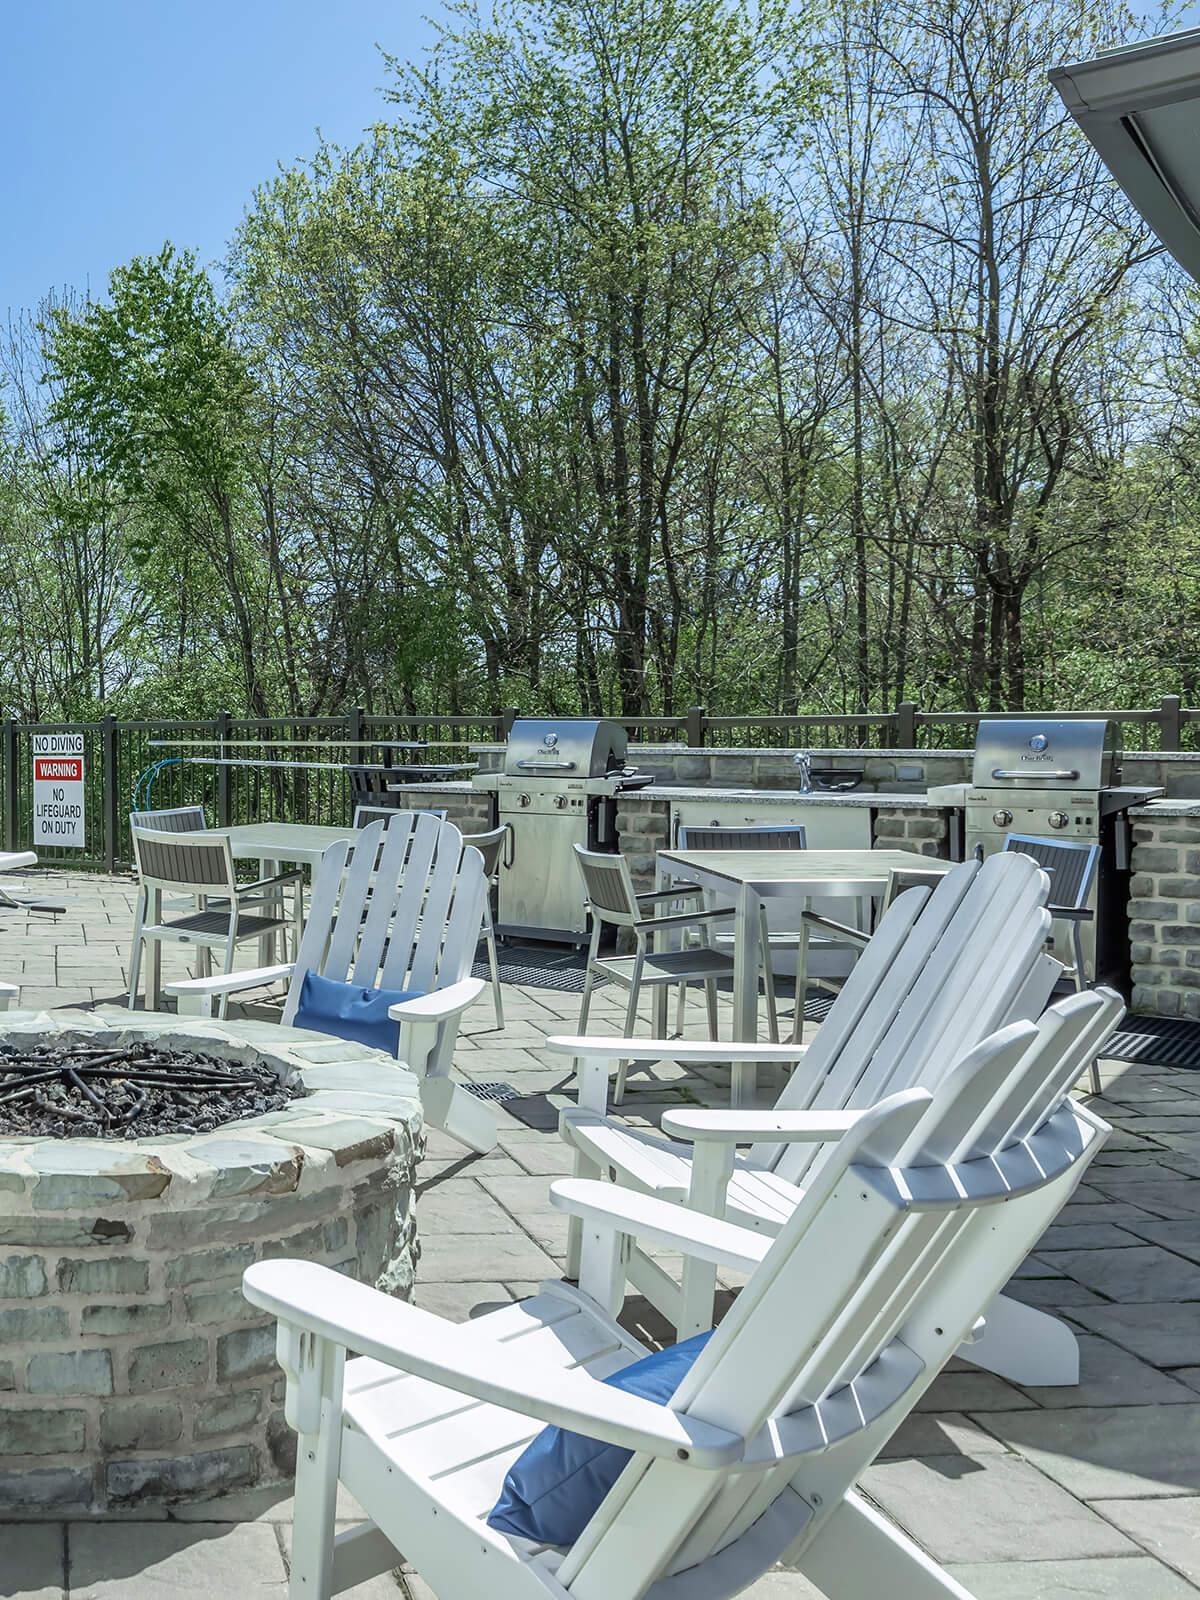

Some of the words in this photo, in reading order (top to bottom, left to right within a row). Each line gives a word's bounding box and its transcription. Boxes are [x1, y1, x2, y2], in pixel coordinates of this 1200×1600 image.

[35, 736, 49, 751] NO
[51, 736, 82, 751] DIVING
[40, 762, 78, 777] WARNING
[52, 788, 65, 801] NO
[36, 804, 81, 818] LIFEGUARD
[41, 820, 53, 834] ON
[55, 821, 76, 834] DUTY
